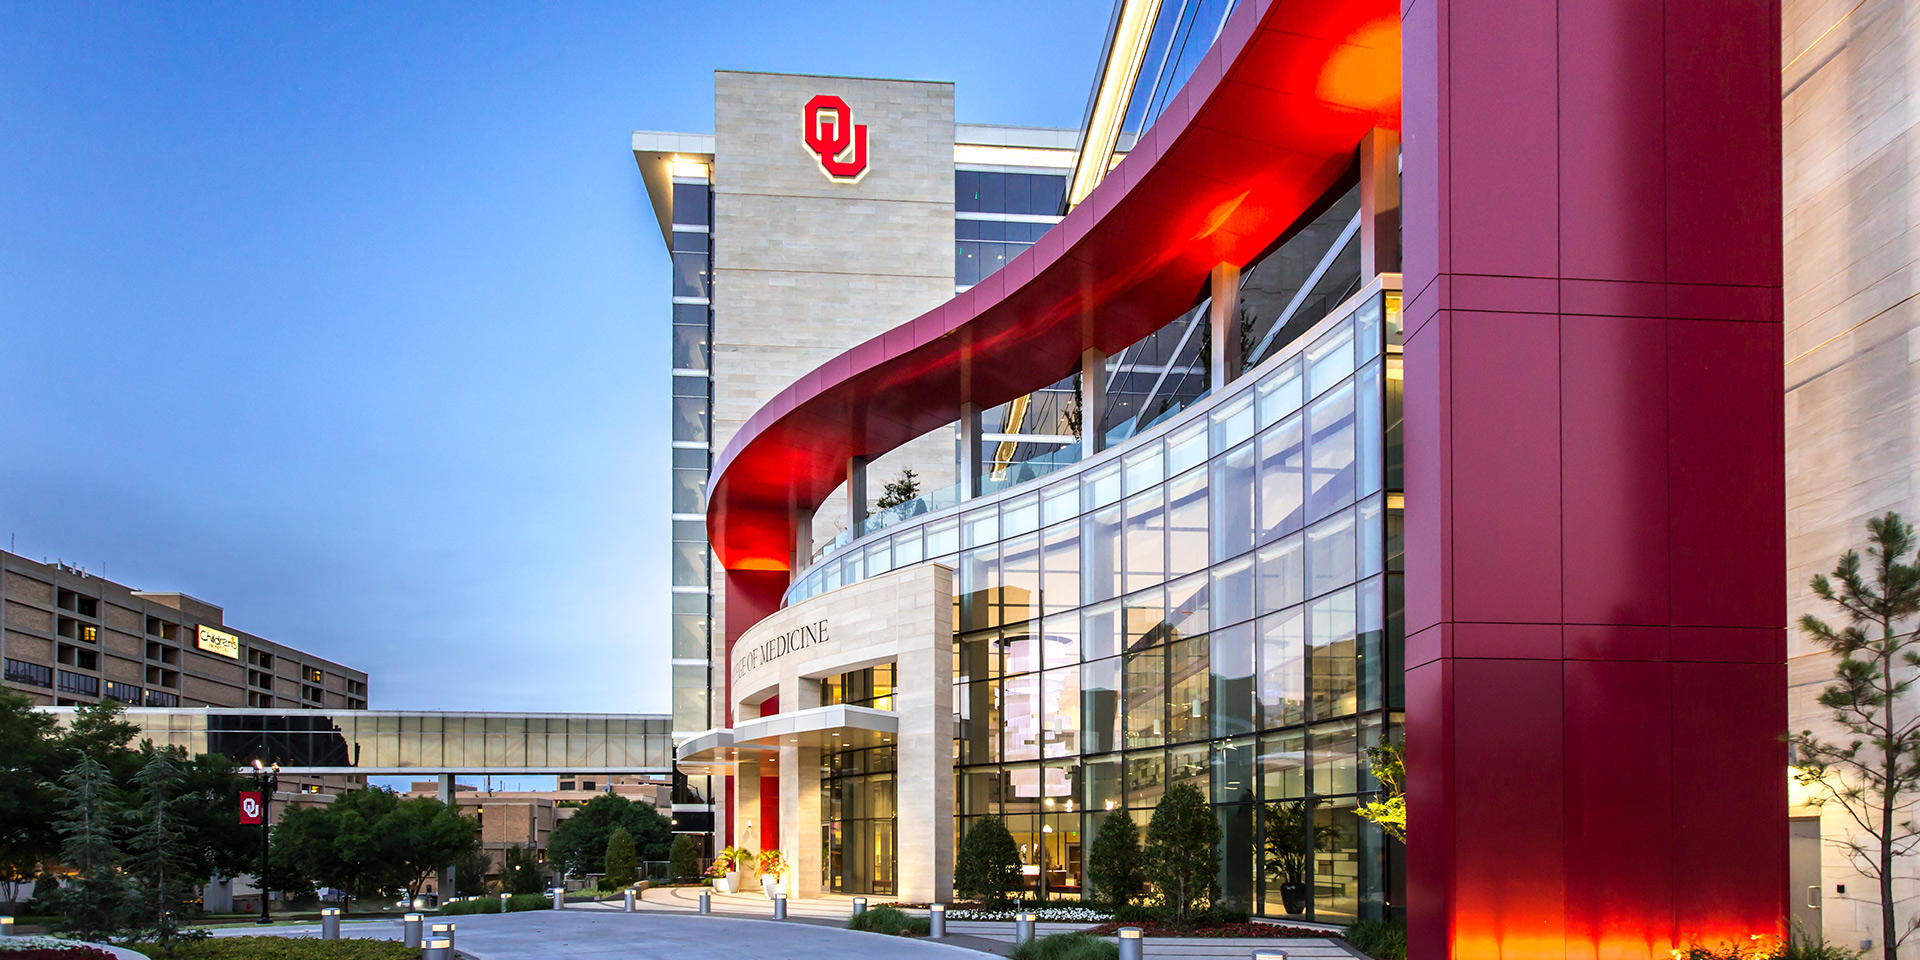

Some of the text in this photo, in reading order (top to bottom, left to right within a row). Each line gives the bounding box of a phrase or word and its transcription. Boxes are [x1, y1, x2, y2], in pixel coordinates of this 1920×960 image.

[804, 94, 867, 177] OU
[747, 619, 829, 671] OF MEDICINE
[243, 797, 259, 817] OU
